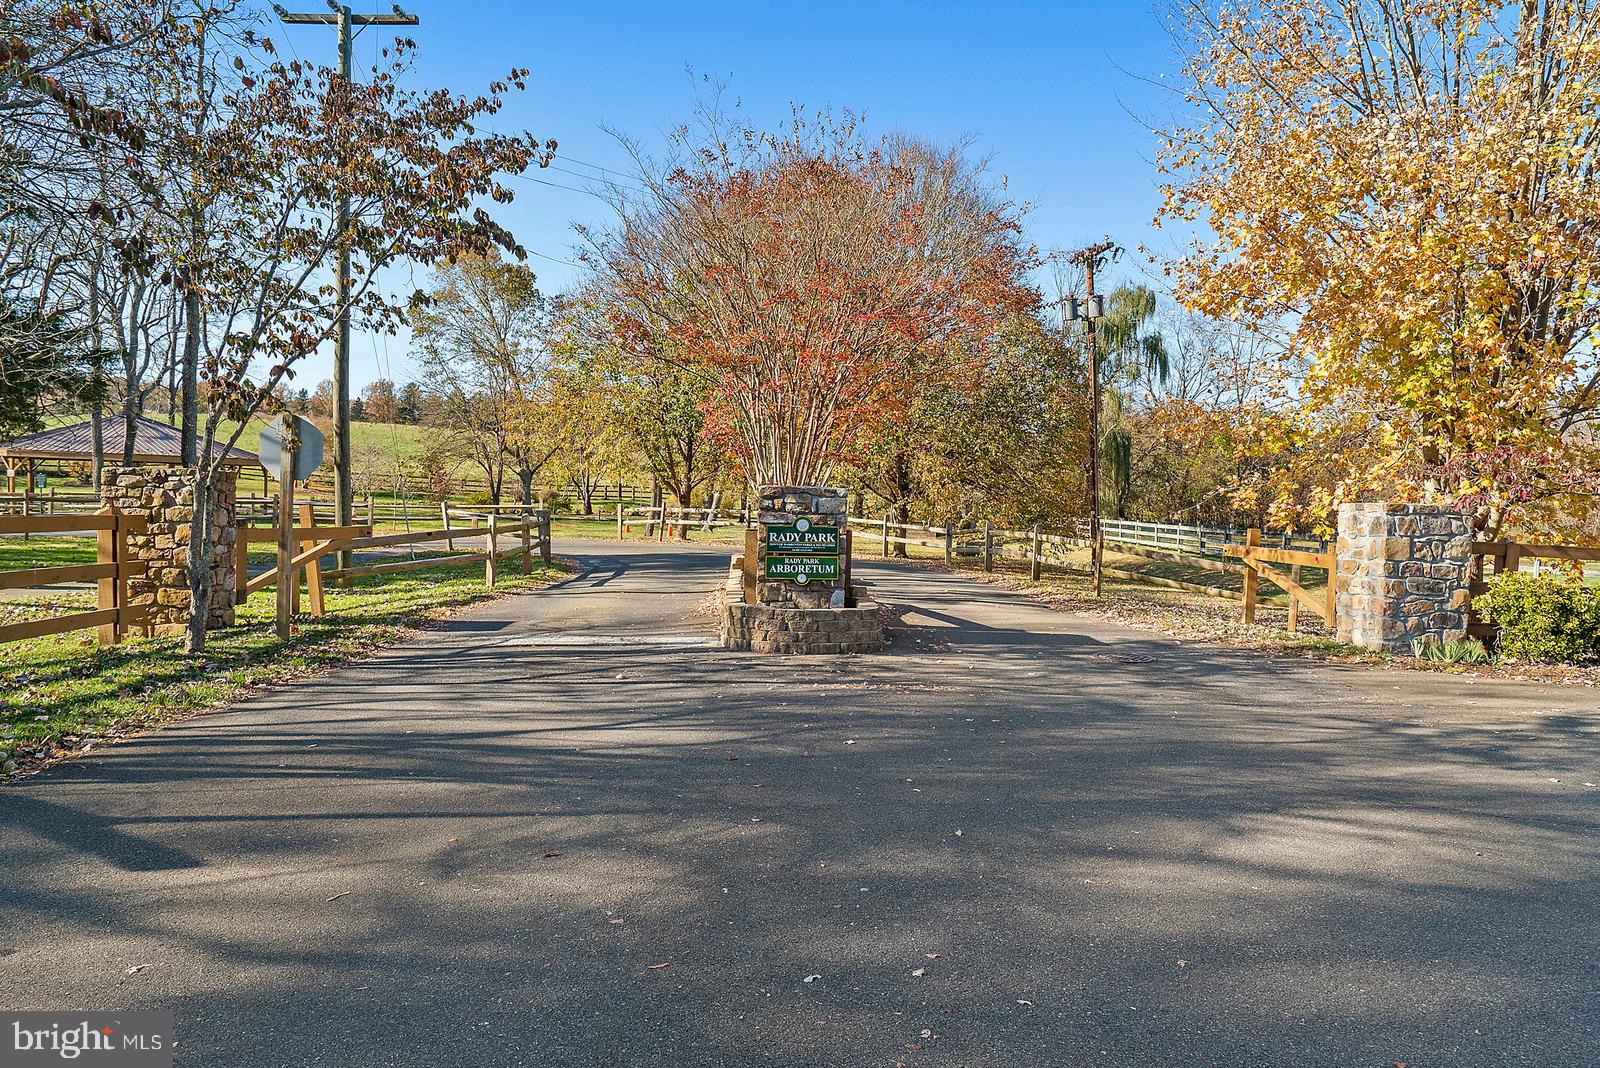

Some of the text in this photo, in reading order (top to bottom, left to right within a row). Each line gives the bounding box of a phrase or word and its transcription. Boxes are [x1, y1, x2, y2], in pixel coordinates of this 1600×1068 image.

[769, 532, 836, 542] RADY PARK
[769, 565, 834, 573] ARBORETUM
